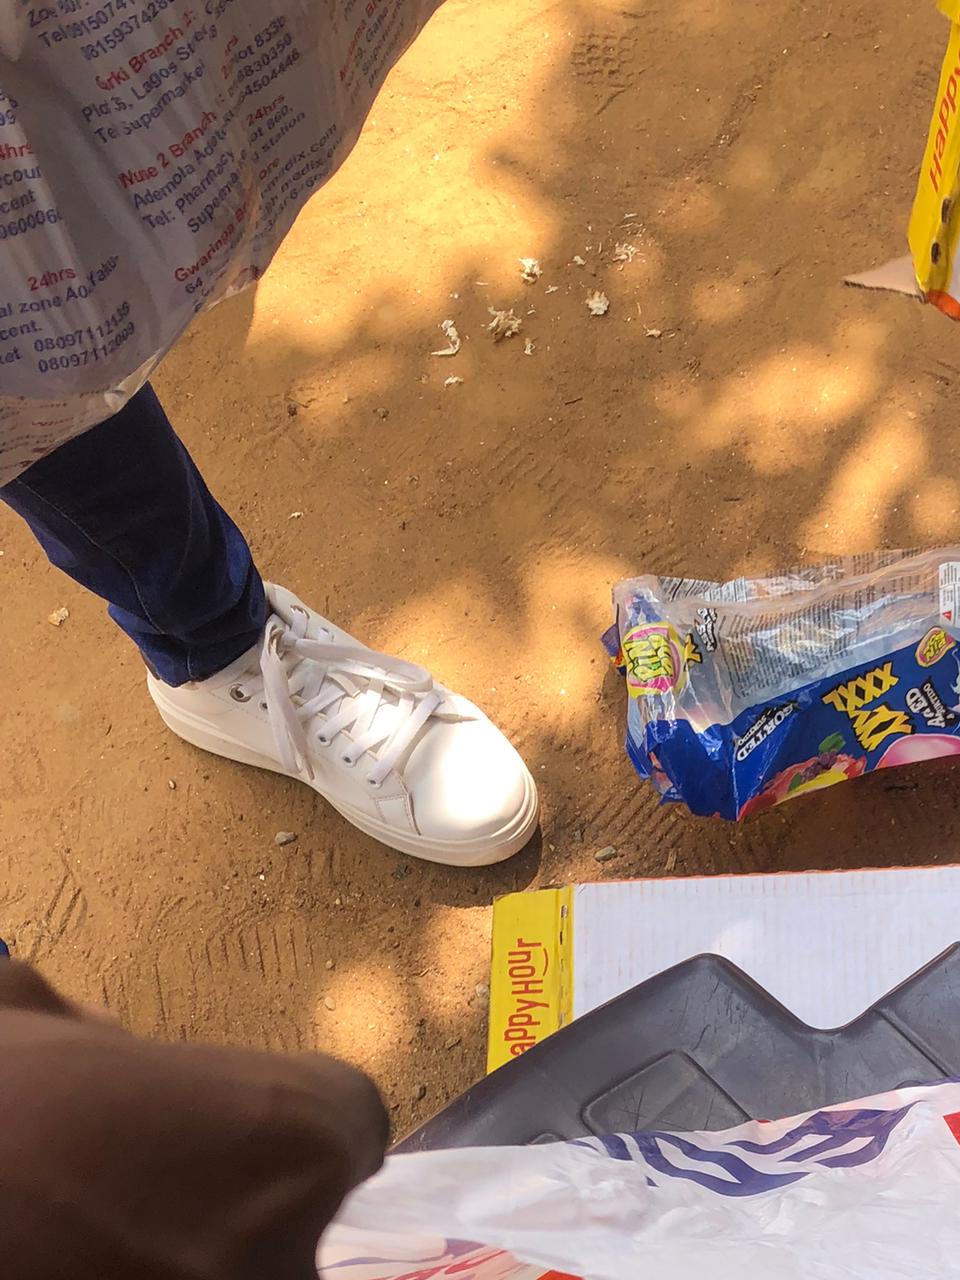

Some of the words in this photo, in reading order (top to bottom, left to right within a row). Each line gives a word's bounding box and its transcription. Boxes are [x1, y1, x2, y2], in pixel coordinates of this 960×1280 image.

[128, 26, 184, 73] Branch
[131, 61, 178, 100] Lagos
[156, 152, 170, 169] 2
[168, 110, 217, 158] Branch
[133, 162, 197, 209] Ademola
[142, 208, 176, 230] Tel:
[174, 149, 236, 215] Pharmacy
[27, 267, 77, 292] 24hrs
[19, 293, 62, 315] zone
[508, 937, 547, 997] Hour
[510, 990, 551, 1057] appy
